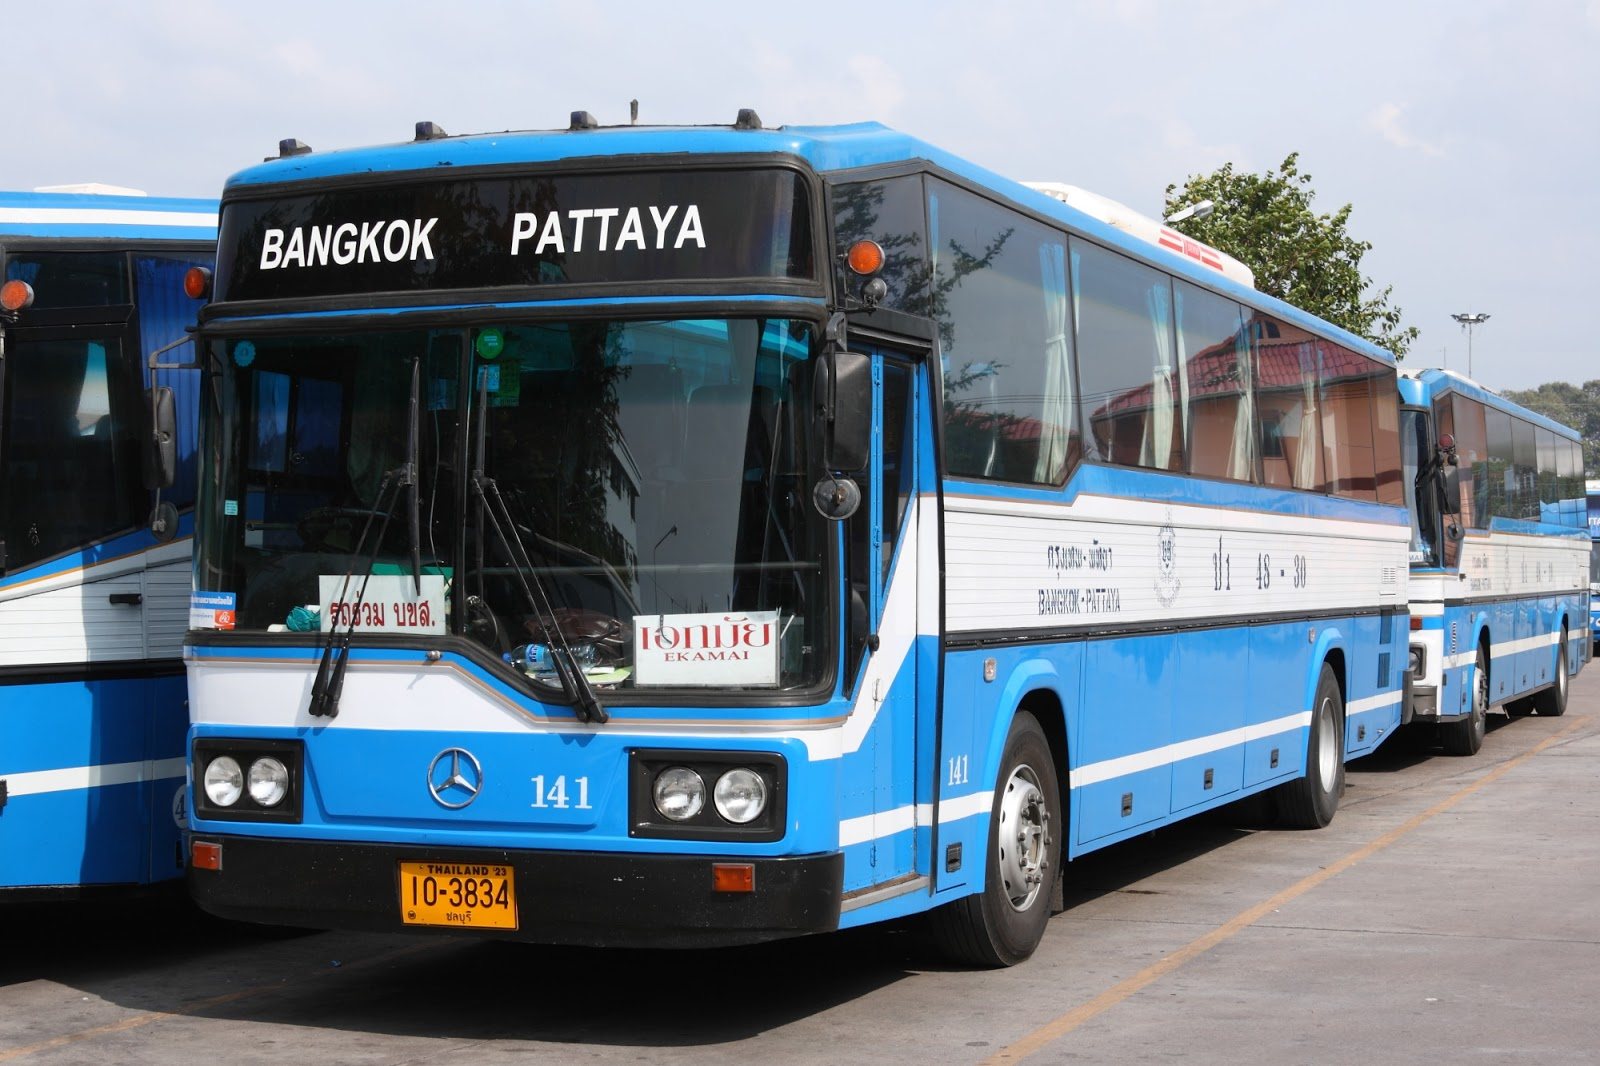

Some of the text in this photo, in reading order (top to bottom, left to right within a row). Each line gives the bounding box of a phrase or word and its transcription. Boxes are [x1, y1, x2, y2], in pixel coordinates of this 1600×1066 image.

[259, 203, 707, 270] BANGKOK PATTAYA
[1293, 554, 1307, 589] 30
[393, 600, 436, 628] บขส.
[640, 616, 770, 650] เอกมัย
[664, 650, 750, 662] EKAMAI
[947, 754, 969, 786] 141
[530, 774, 593, 810] 141
[427, 864, 489, 876] THAILAND
[412, 876, 509, 909] 10-3834
